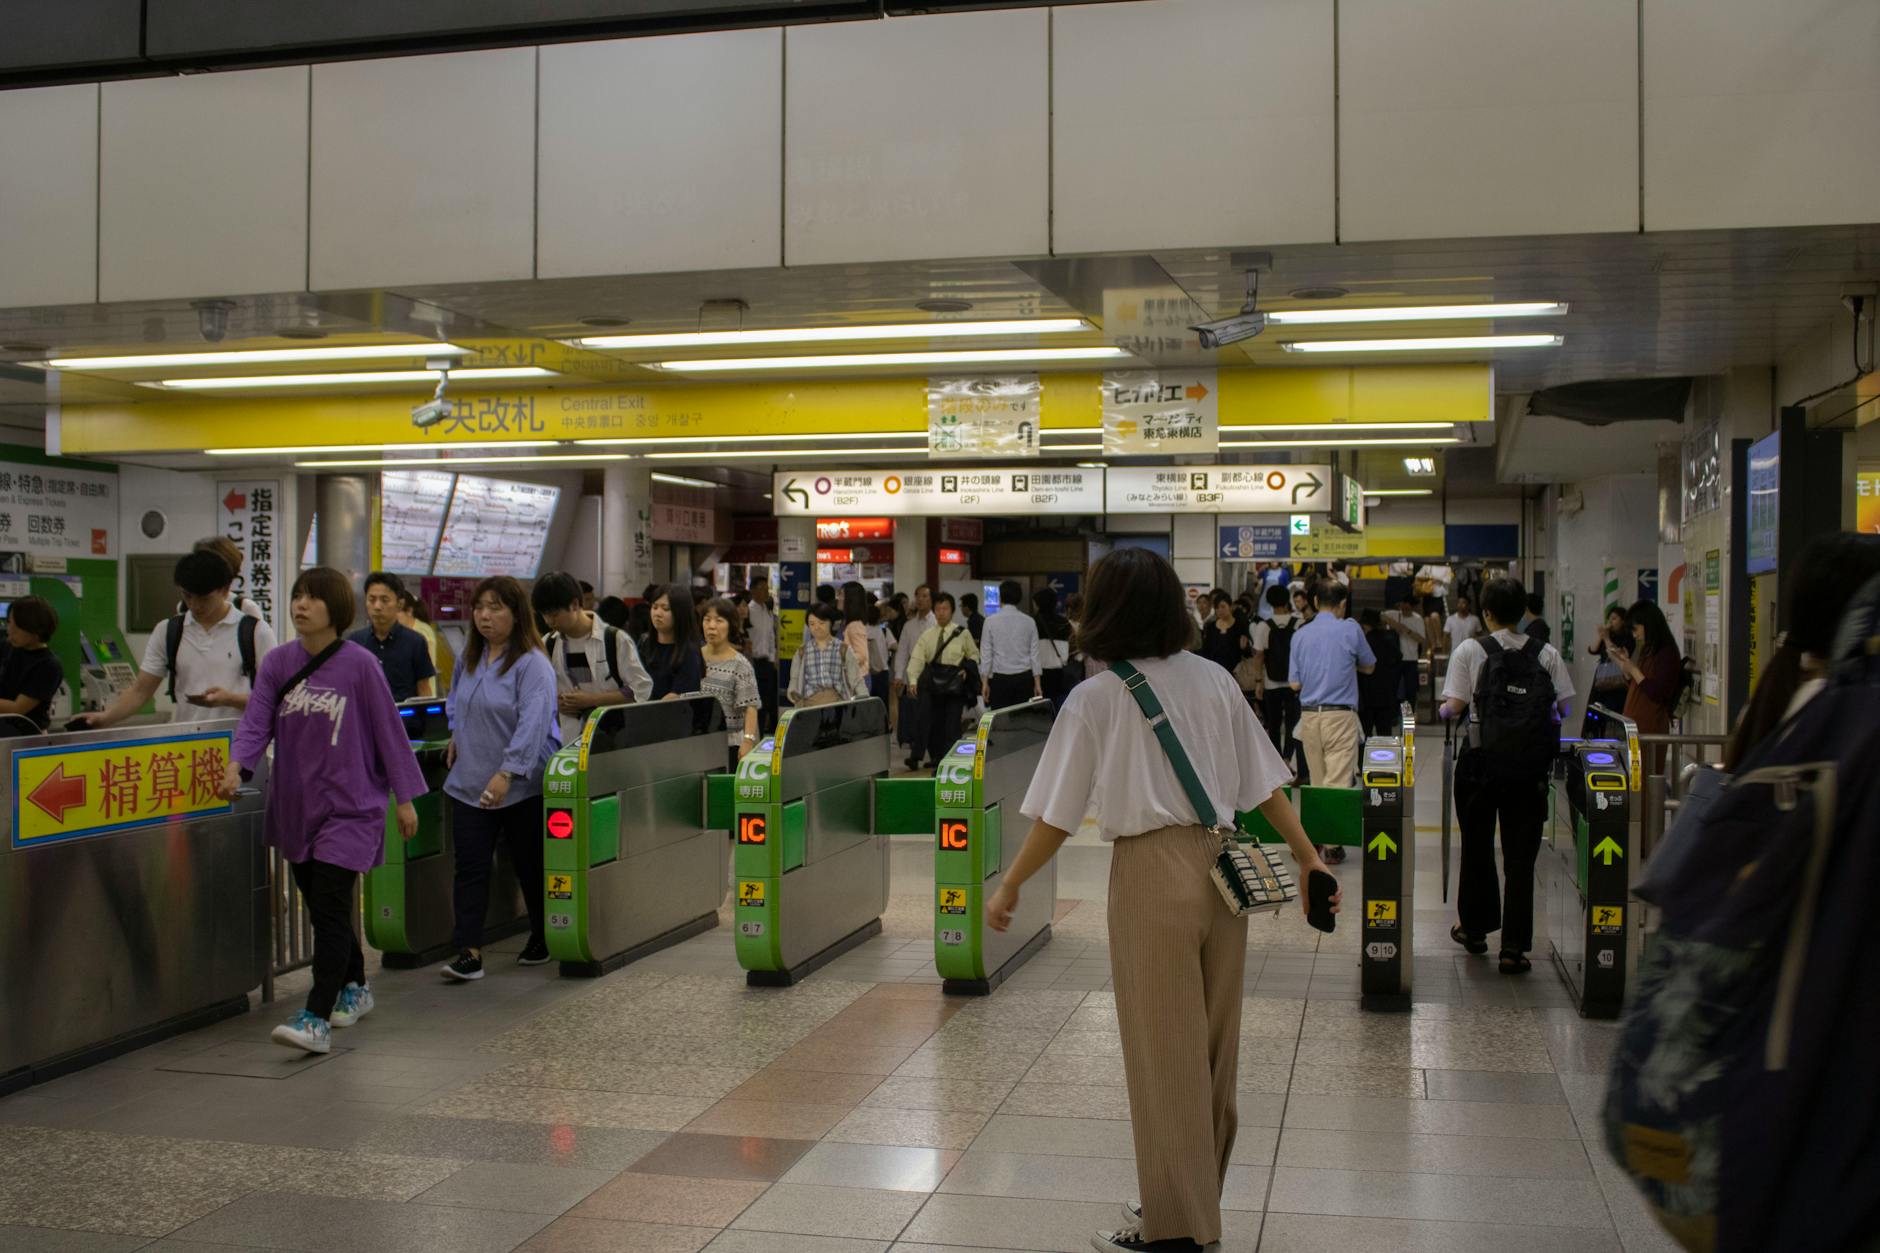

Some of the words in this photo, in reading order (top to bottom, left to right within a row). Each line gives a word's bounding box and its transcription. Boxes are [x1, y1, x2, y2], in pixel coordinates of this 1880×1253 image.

[561, 397, 613, 411] Central
[618, 395, 645, 409] Exit
[636, 414, 658, 427] 중앙
[833, 476, 873, 487] 半蔵門線
[903, 475, 933, 486] 銀座線
[960, 475, 1001, 485] 井の頭線
[1031, 474, 1082, 485] 田園都市線
[1156, 472, 1187, 483] 東横線
[1221, 472, 1264, 483] 副都心線
[833, 497, 859, 505] (B2F)
[960, 495, 980, 504] (2F)
[1031, 494, 1058, 504] (B2F)
[1196, 493, 1224, 503] (B3F)
[28, 514, 65, 535] 回数券
[251, 488, 272, 627] 指定席券売
[549, 757, 578, 776] IC
[739, 760, 770, 780] IC
[940, 765, 972, 785] IC
[99, 747, 225, 819] 精算機
[548, 780, 571, 793] 専用
[739, 785, 764, 798] 専用
[940, 790, 966, 803] 専用
[741, 818, 766, 842] IC
[942, 823, 967, 848] IC
[551, 915, 557, 924] 5
[562, 916, 568, 925] 6
[742, 924, 749, 932] 6
[754, 924, 761, 932] 7
[943, 931, 949, 940] 7
[955, 931, 962, 941] 8
[1371, 945, 1378, 955] 9
[1384, 945, 1393, 955] 10
[1602, 952, 1612, 962] 10
